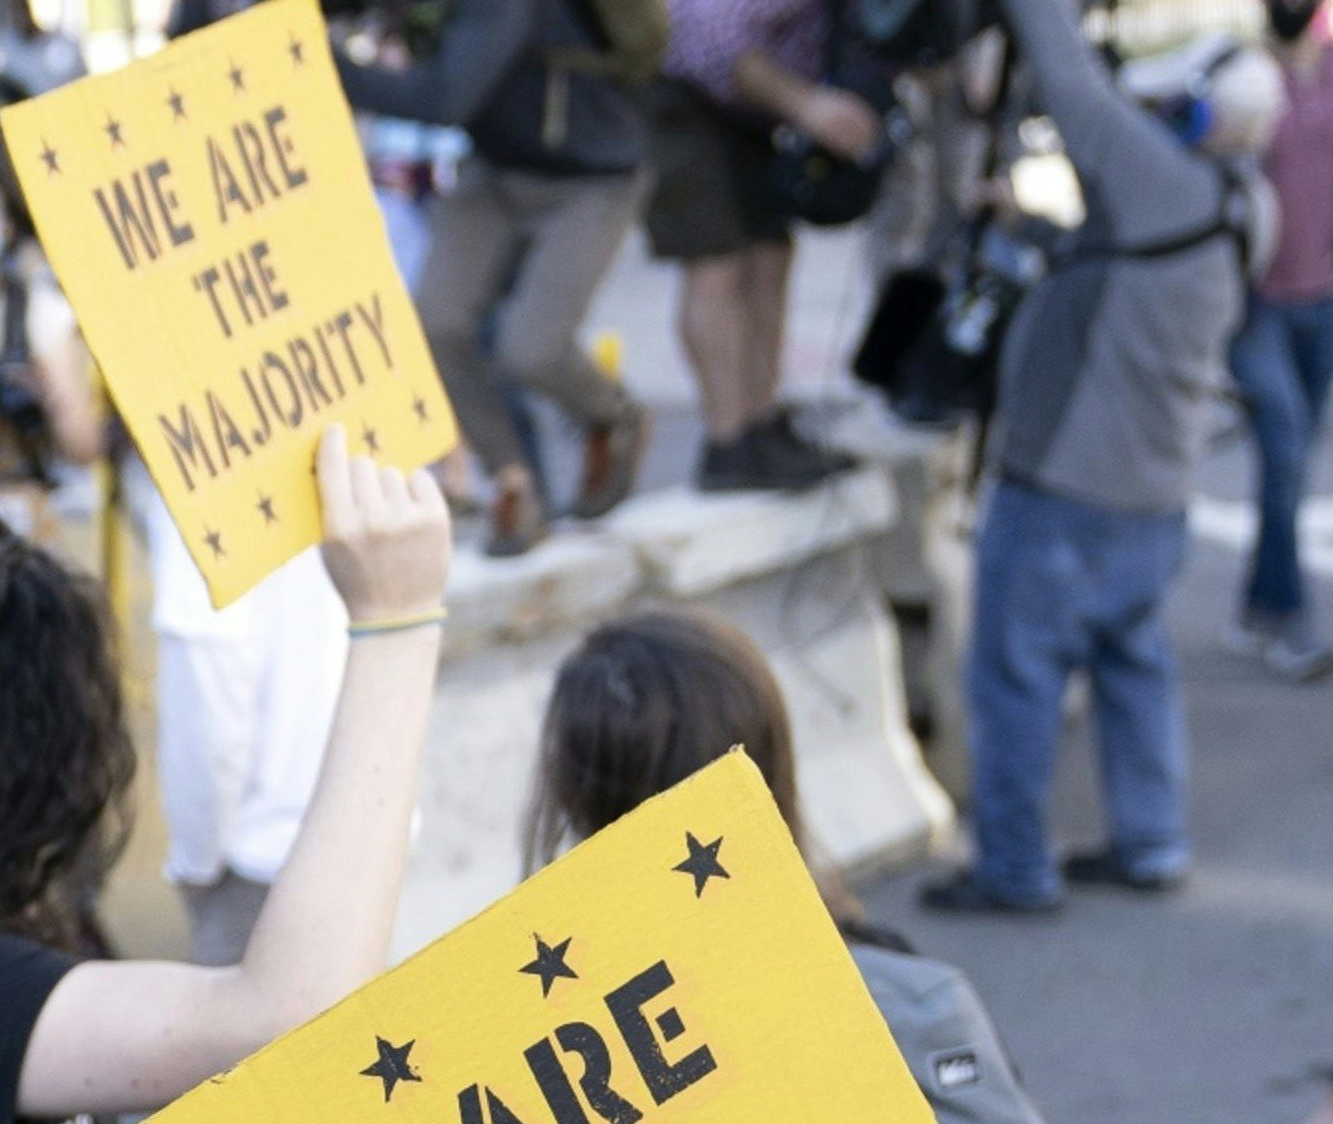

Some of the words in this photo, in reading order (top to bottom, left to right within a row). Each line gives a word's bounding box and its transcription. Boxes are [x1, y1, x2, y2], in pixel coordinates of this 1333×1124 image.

[92, 159, 195, 271] WE
[205, 105, 308, 224] ARE
[192, 241, 290, 338] THE
[158, 294, 393, 492] MAJORITY
